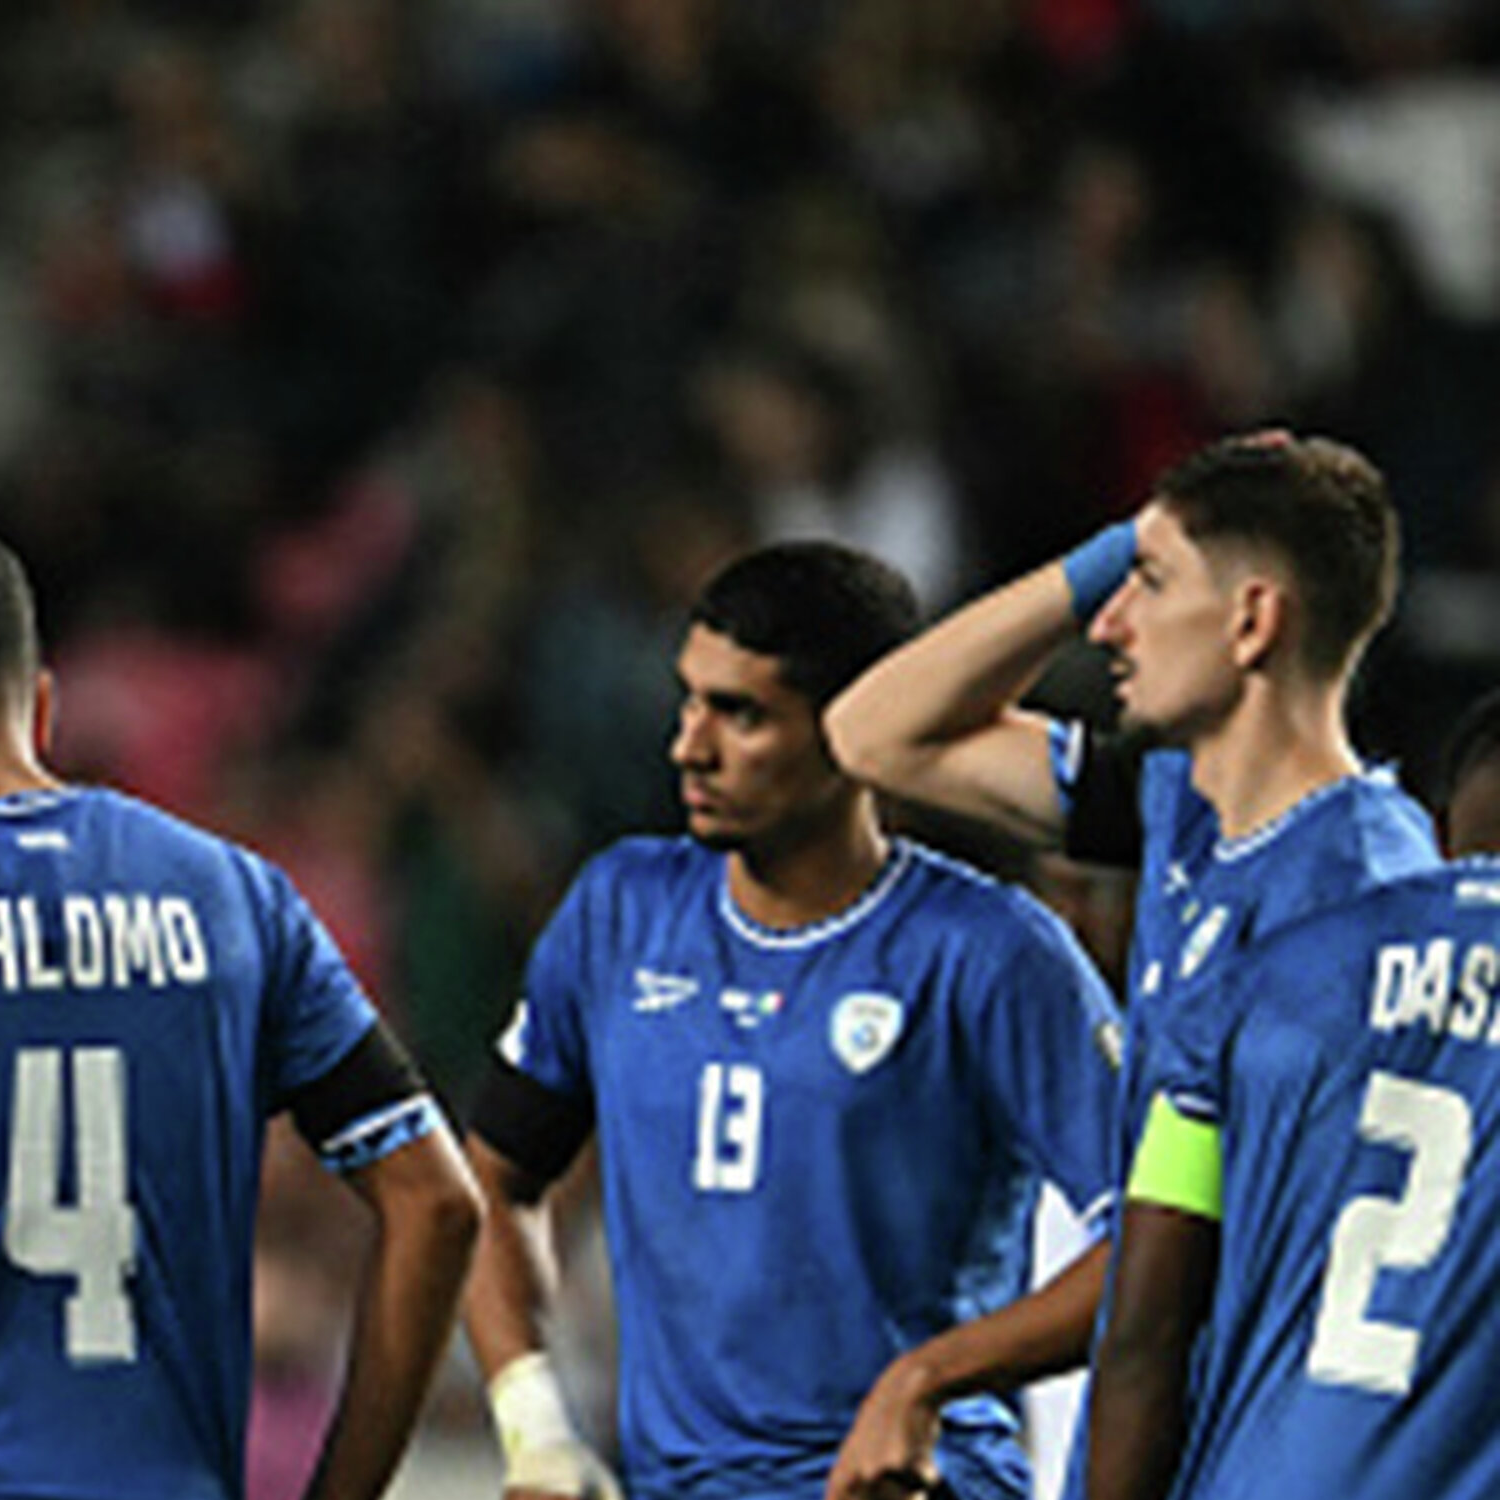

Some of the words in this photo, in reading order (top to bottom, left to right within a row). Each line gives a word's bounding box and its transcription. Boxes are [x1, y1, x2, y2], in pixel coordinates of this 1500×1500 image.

[1368, 936, 1500, 1046] DAS
[4, 1046, 136, 1363] 4
[693, 1063, 764, 1192] 13
[1305, 1070, 1473, 1395] 2
